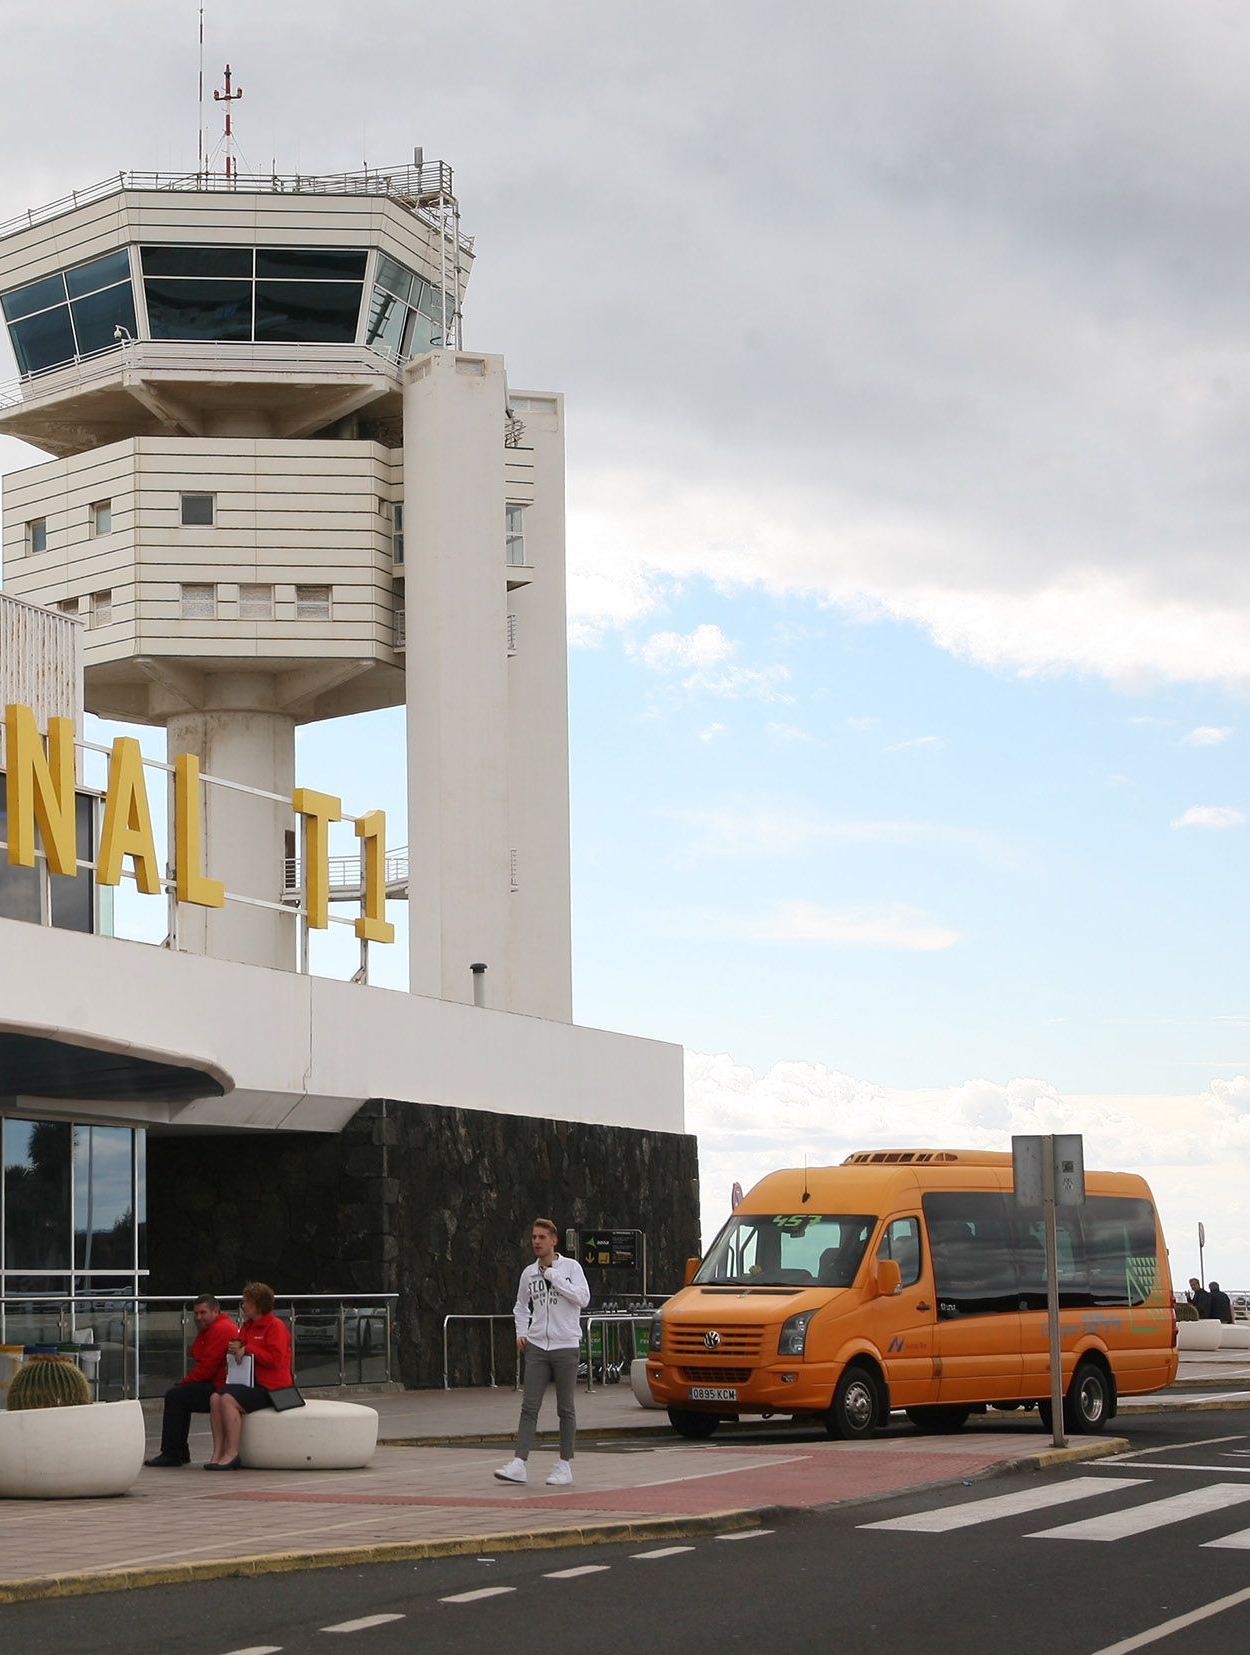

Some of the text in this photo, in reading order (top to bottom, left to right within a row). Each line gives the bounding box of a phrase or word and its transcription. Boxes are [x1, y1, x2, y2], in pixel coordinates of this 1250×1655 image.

[291, 787, 395, 944] T1
[772, 1214, 823, 1228] 457
[693, 1388, 735, 1400] 0895 KCM
